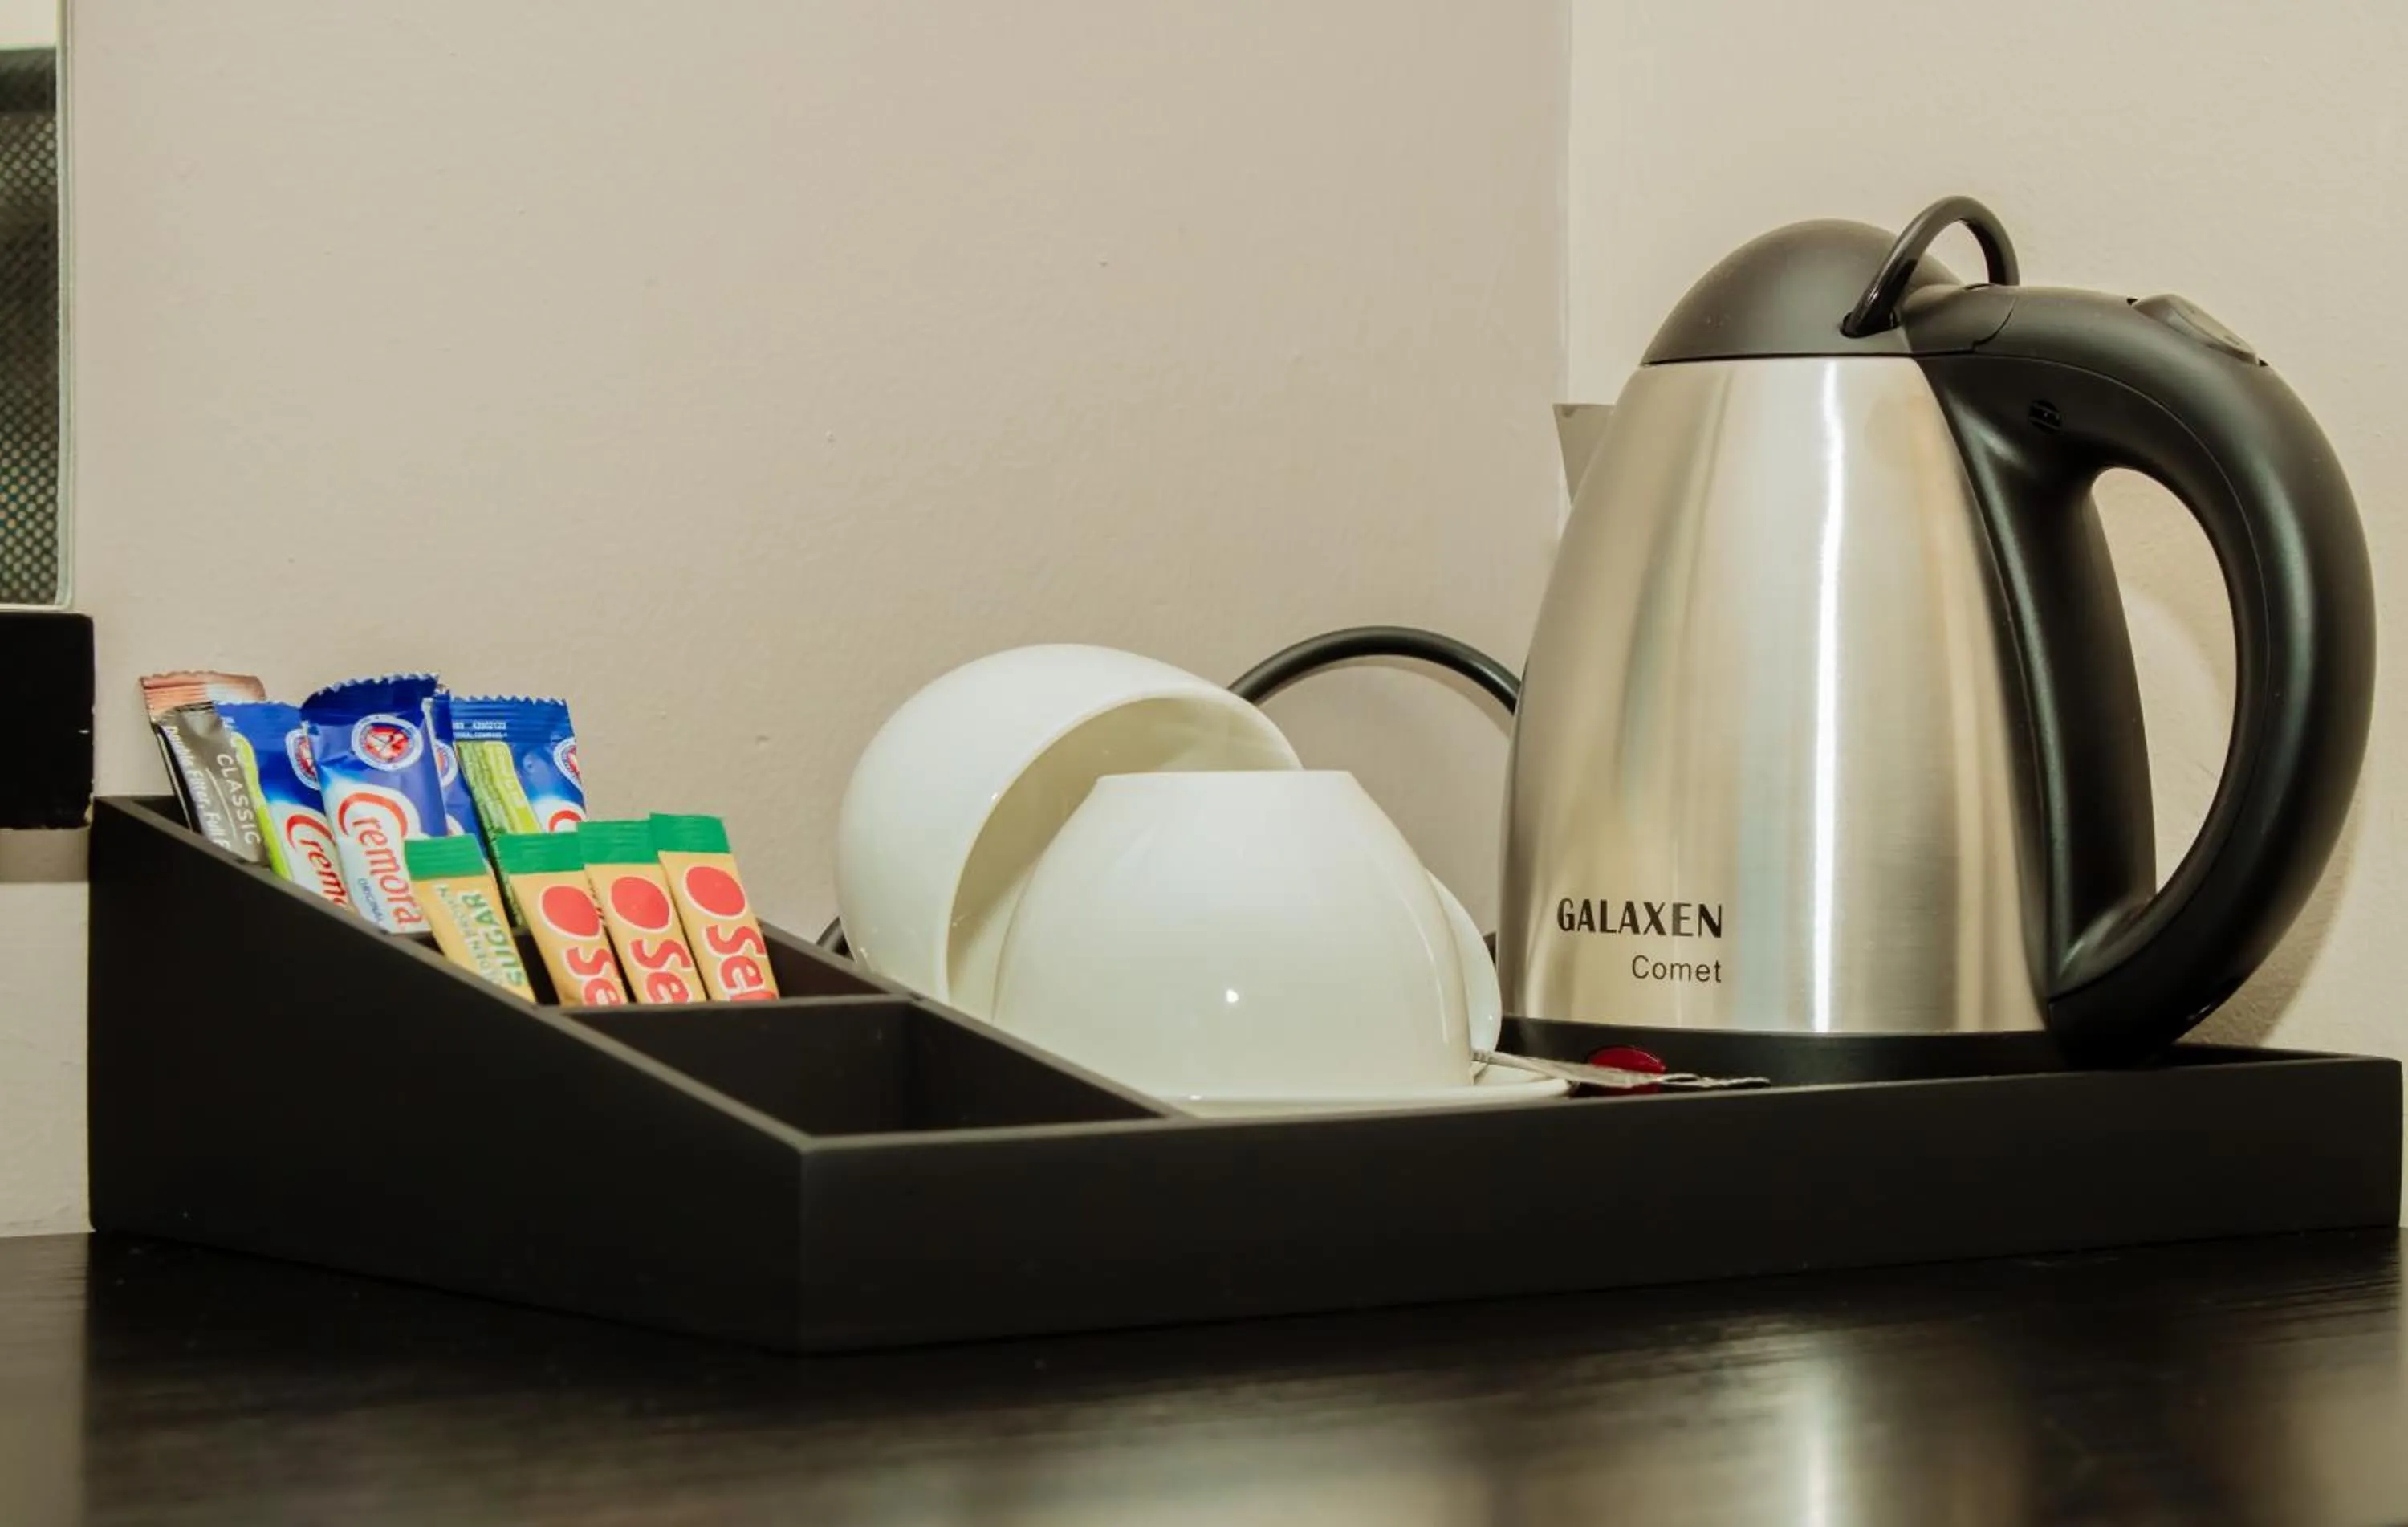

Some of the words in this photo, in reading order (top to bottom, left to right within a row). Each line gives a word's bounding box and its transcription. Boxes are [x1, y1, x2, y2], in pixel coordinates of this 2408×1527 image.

[216, 753, 261, 845] CLASSIC
[286, 814, 347, 906] Crem
[337, 792, 423, 925] Cremora
[461, 892, 524, 987] SUGAR
[1557, 897, 1723, 939] GALAXEN
[1631, 955, 1722, 983] Comet
